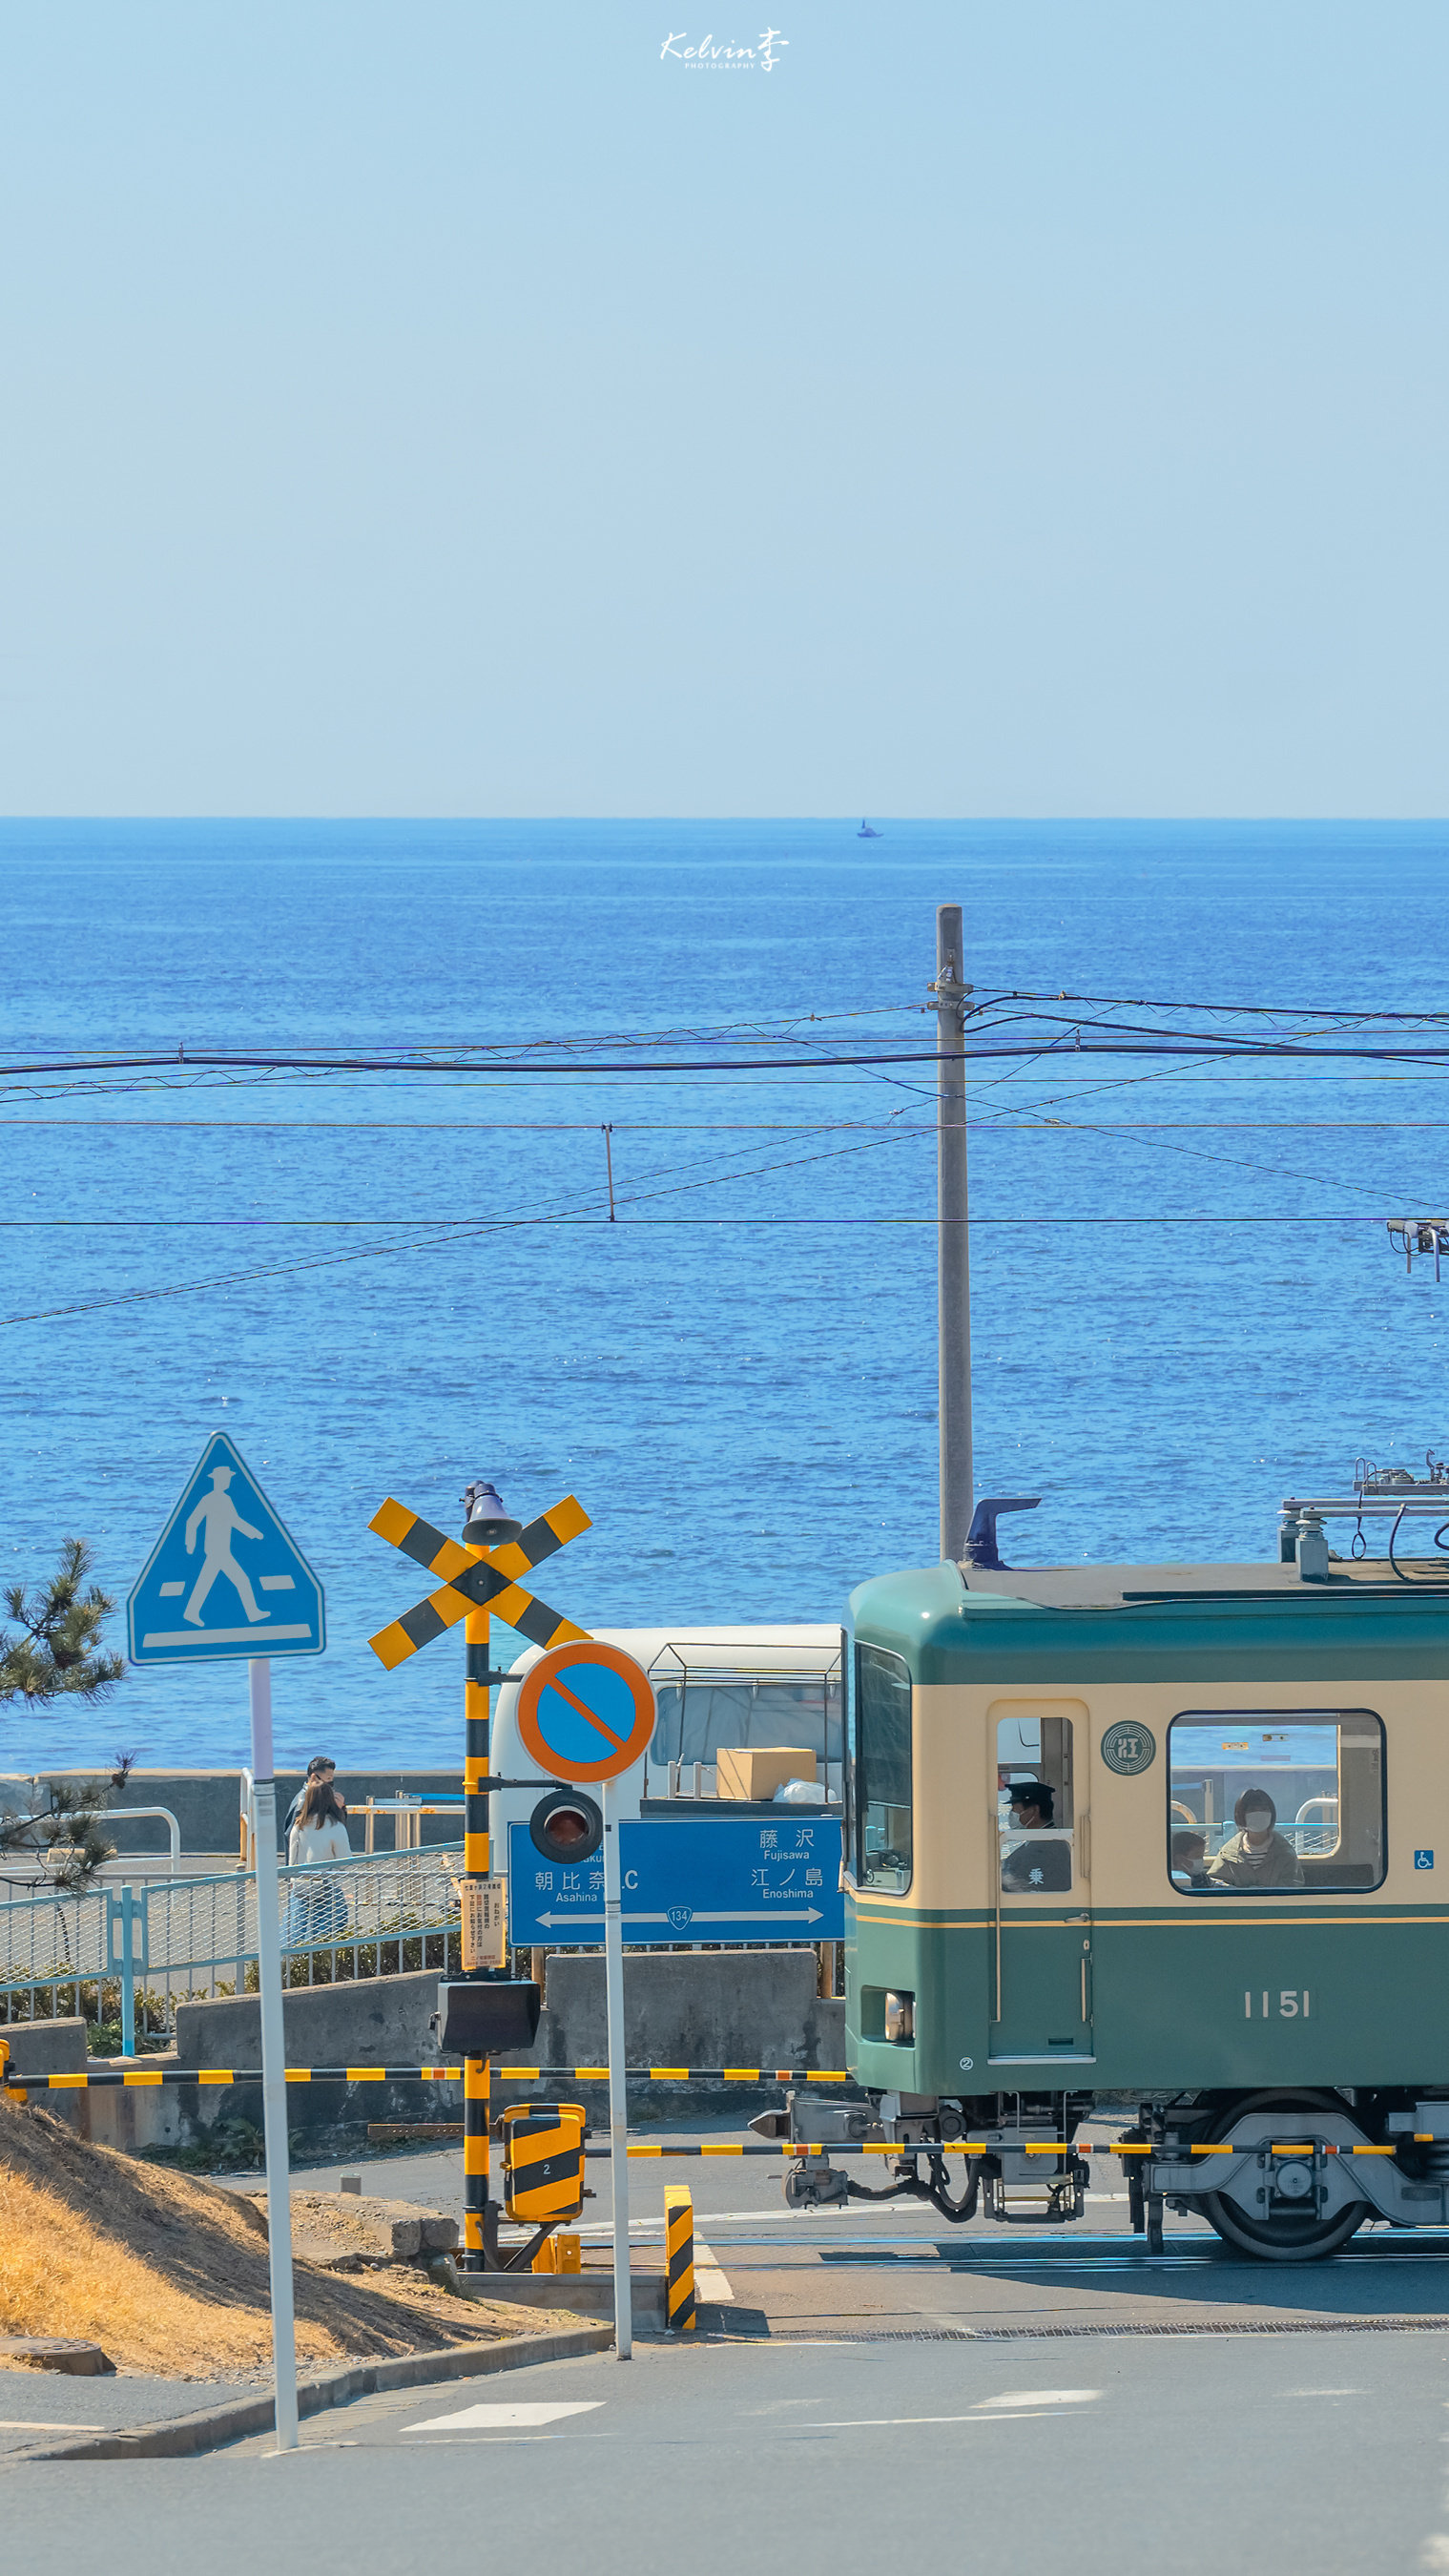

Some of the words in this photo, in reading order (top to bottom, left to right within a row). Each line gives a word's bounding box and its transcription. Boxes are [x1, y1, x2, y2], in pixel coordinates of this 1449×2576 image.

[759, 1829, 815, 1849] 藤沢
[764, 1850, 810, 1862] Fujisawa
[751, 1867, 823, 1887] 江ノ島
[555, 1892, 598, 1902] Asahina
[763, 1888, 814, 1899] Enoshima
[672, 1910, 687, 1922] 134
[1244, 1990, 1310, 2018] 1151
[543, 2164, 551, 2174] 2
